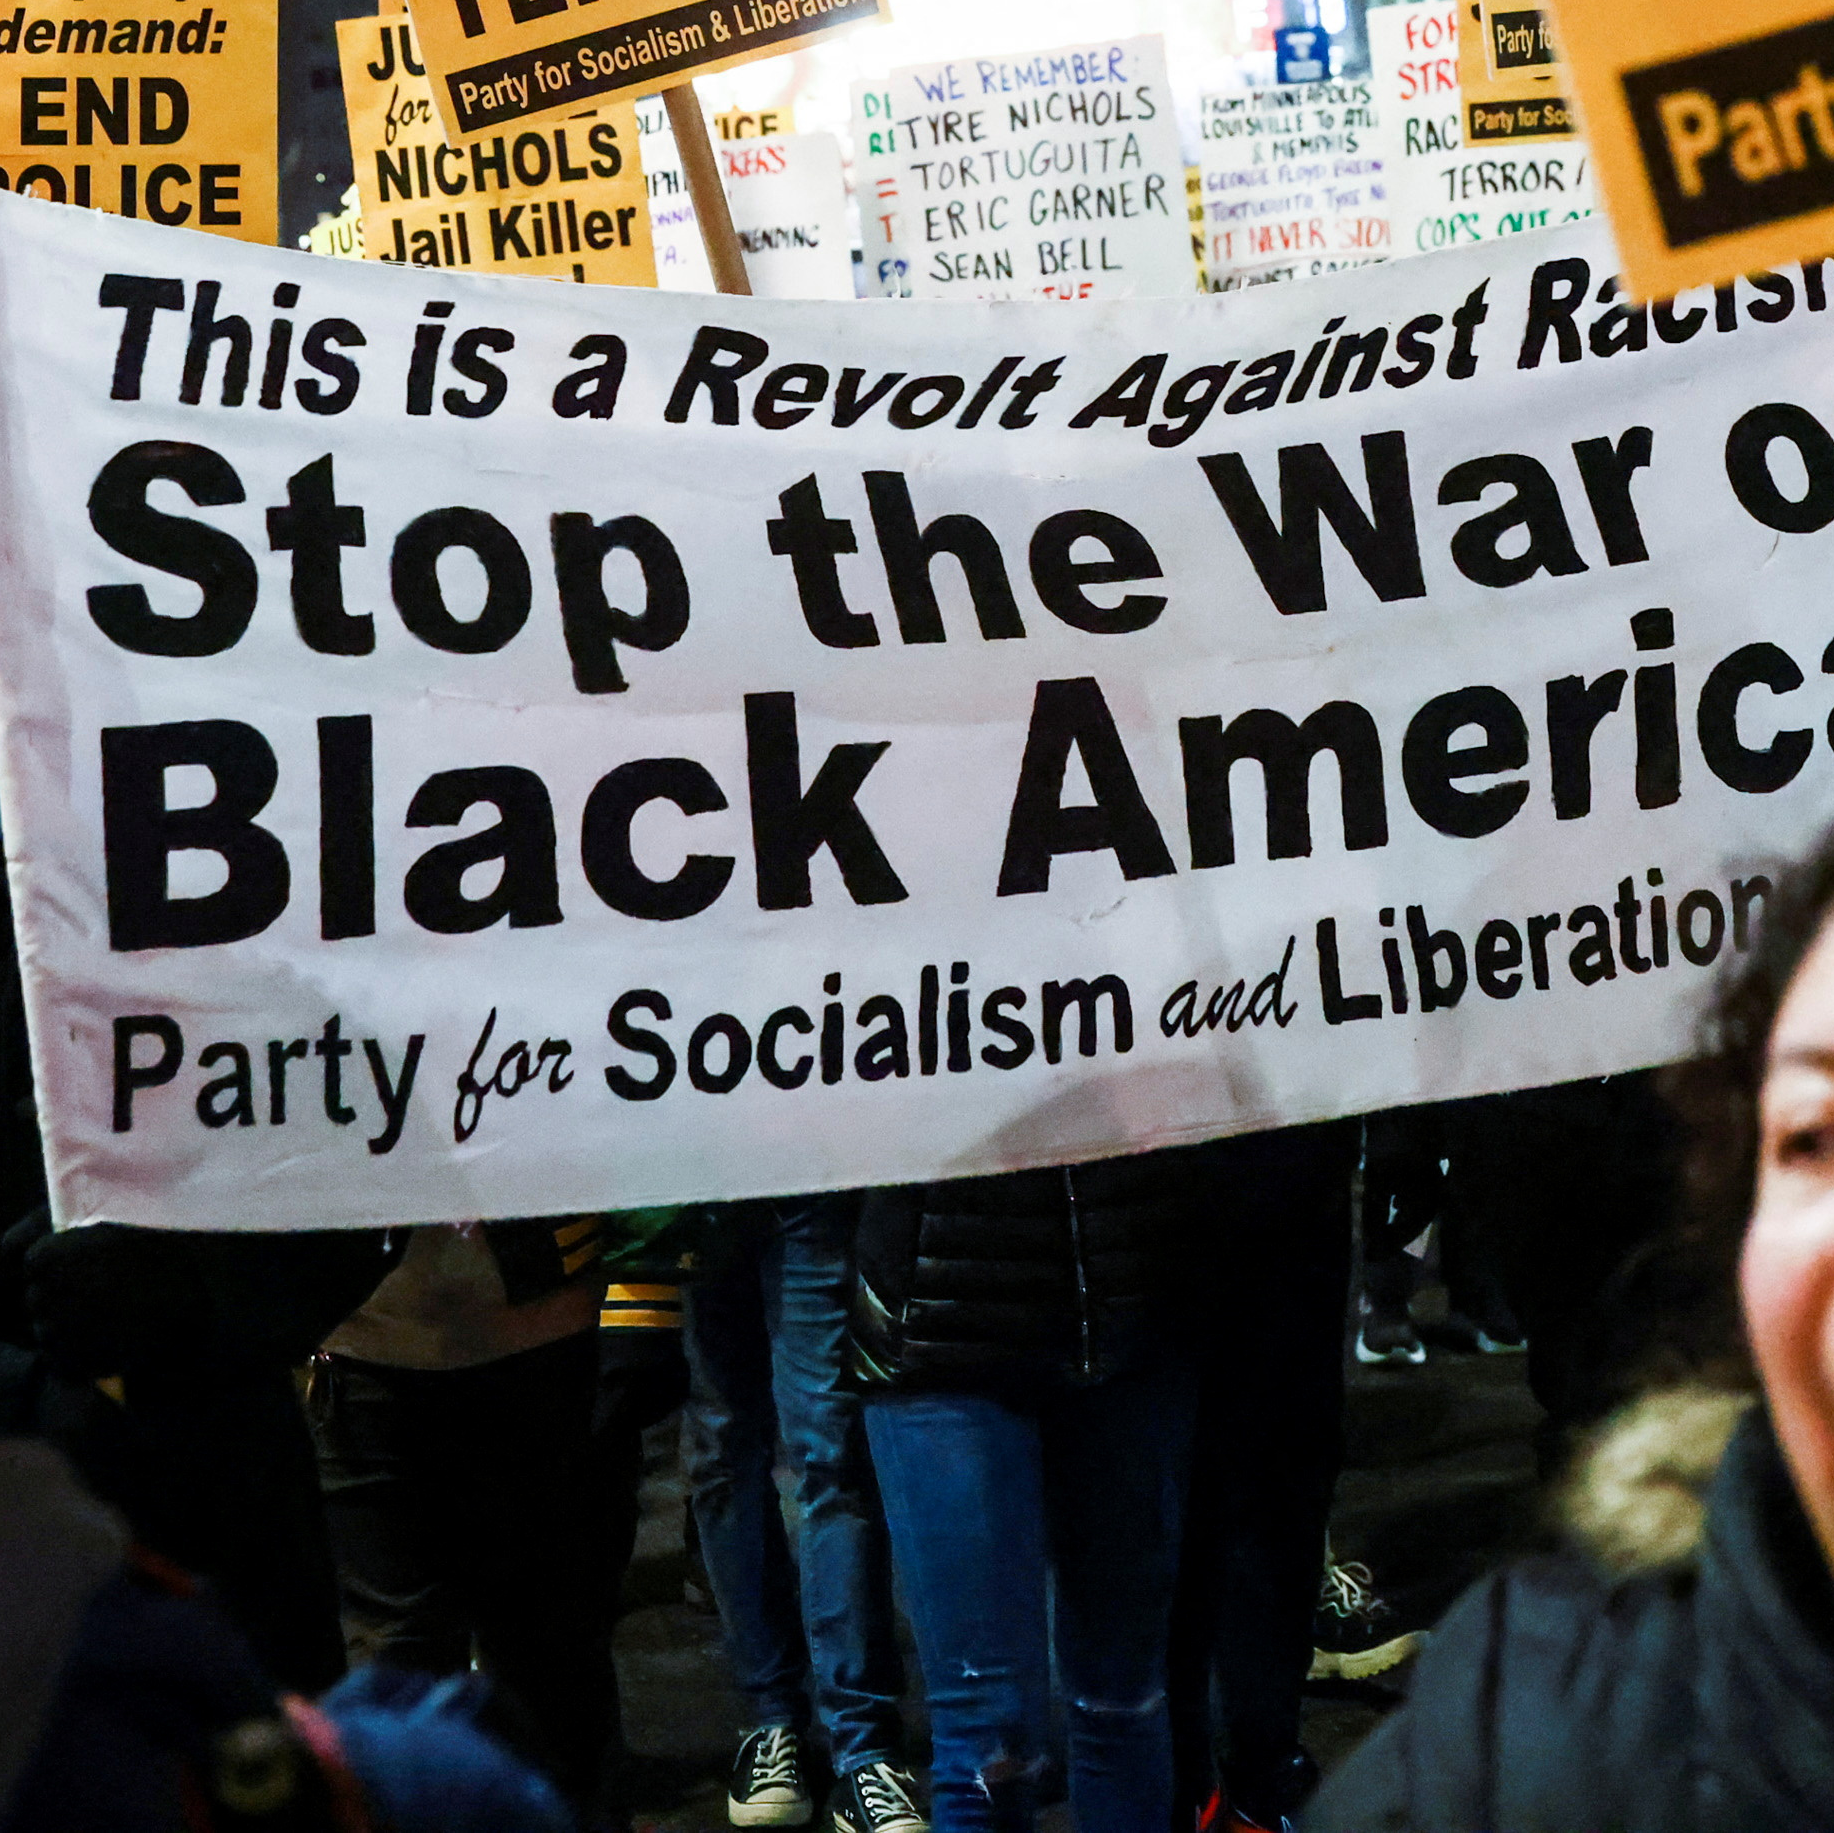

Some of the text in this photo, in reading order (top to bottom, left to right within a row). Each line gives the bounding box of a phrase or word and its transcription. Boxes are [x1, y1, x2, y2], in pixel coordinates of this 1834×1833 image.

[459, 74, 528, 115] Party
[534, 60, 572, 93] for
[577, 23, 706, 81] Socialism
[711, 11, 731, 42] &
[1496, 24, 1535, 59] Party
[20, 77, 189, 146] END
[385, 83, 432, 146] for
[897, 86, 1156, 150] TYRE NICHOLS
[915, 65, 965, 103] WE
[1474, 109, 1515, 134] Party
[1518, 106, 1540, 128] for
[375, 123, 622, 202] NICHOLS
[910, 133, 1142, 191] TORTUGUITA
[381, 212, 471, 267] Jail
[489, 199, 637, 261] Killer
[925, 196, 1009, 243] ERIC
[1029, 174, 1168, 226] GARNER
[930, 248, 1013, 283] SEAN
[1038, 237, 1123, 276] BELL
[99, 272, 367, 416] This
[407, 301, 514, 418] is
[552, 333, 628, 421] a
[663, 323, 1068, 431] Revolt
[1068, 276, 1492, 449] Against
[86, 438, 691, 694] Stop
[766, 469, 1168, 650] the
[1197, 425, 1655, 616] War
[100, 691, 909, 952] Black
[112, 866, 1775, 1154] Party for Socialism and Liberation
